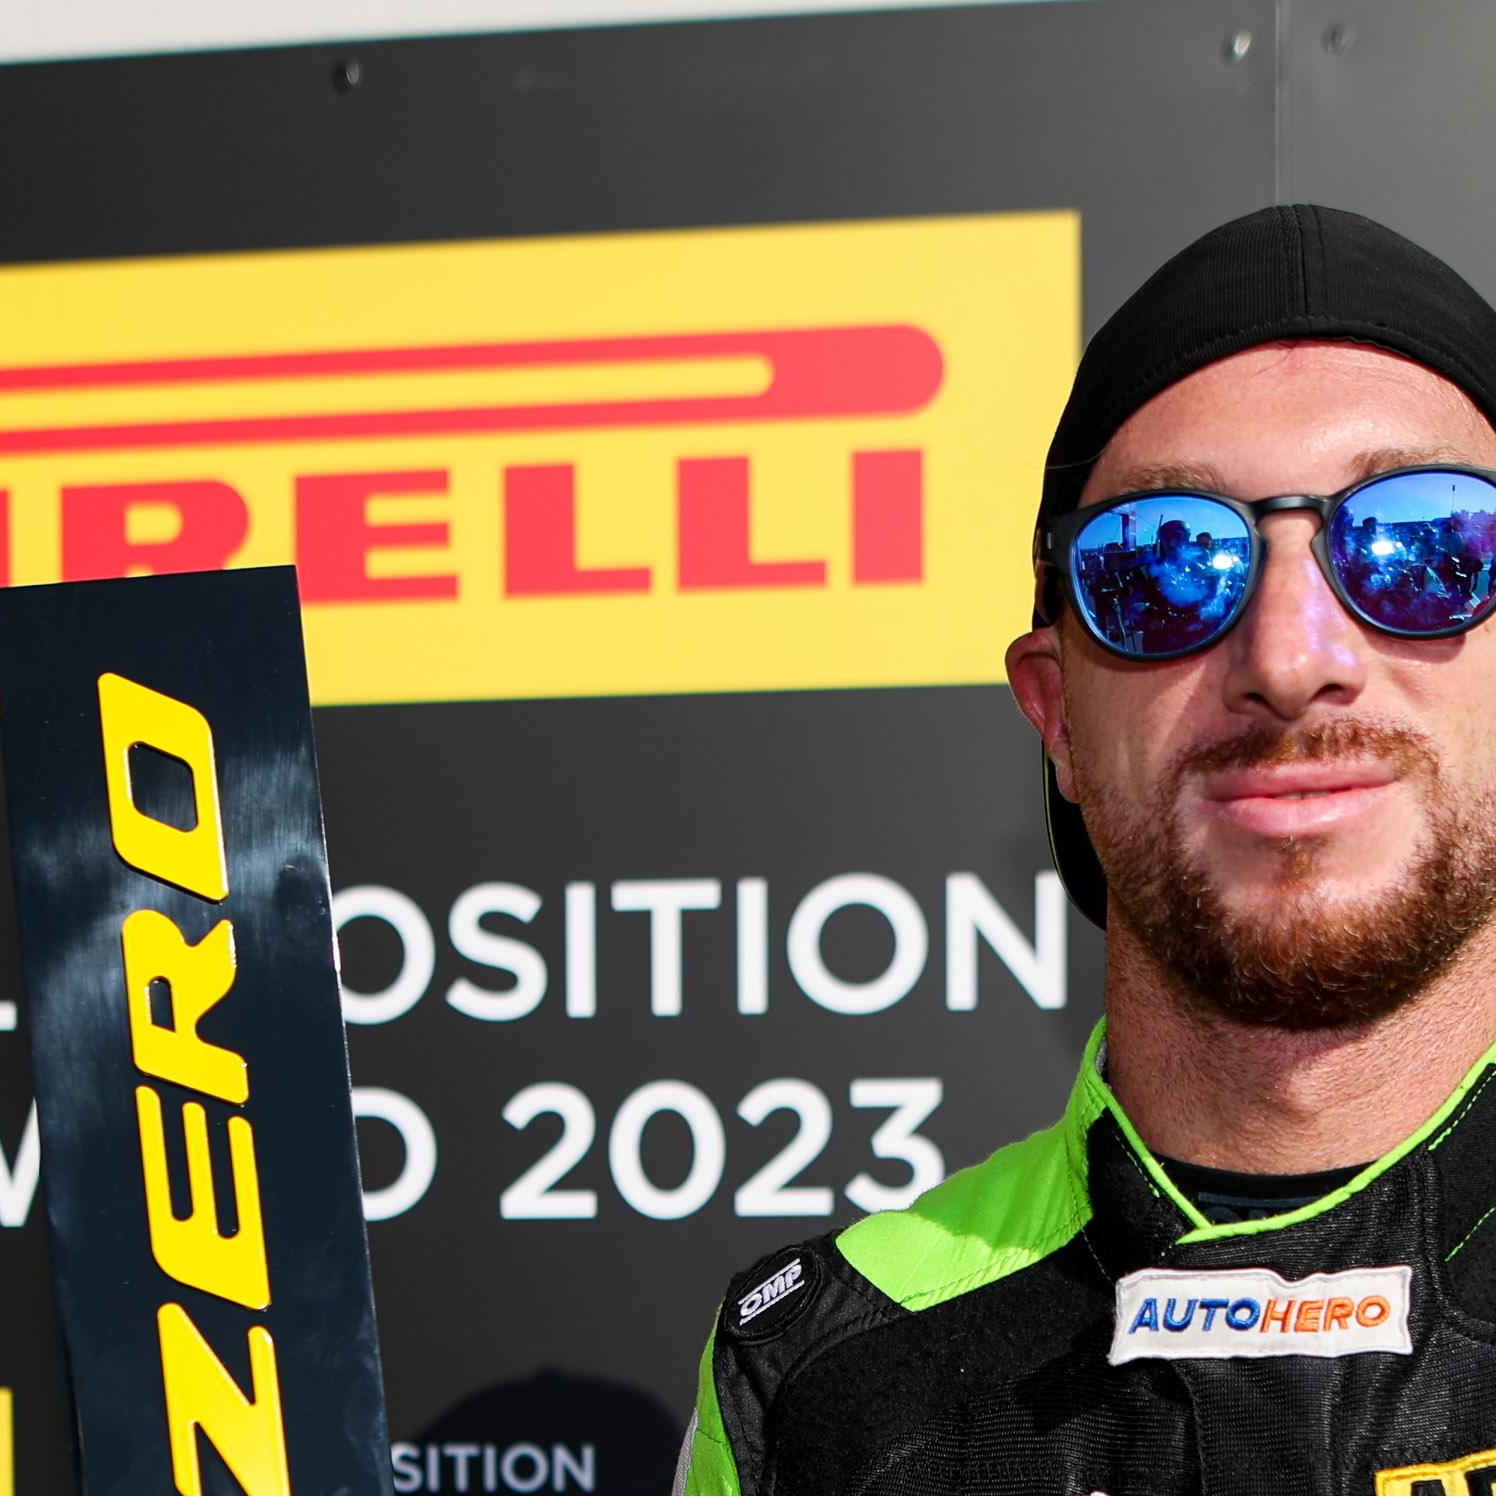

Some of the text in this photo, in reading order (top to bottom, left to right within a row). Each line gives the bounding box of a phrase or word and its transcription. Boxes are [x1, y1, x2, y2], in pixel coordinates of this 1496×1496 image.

[330, 872, 1068, 1026] OSITION
[500, 1077, 944, 1220] 2023
[739, 1264, 803, 1317] OMP
[1128, 1294, 1391, 1334] AUTOHERO
[390, 1441, 596, 1493] SITION
